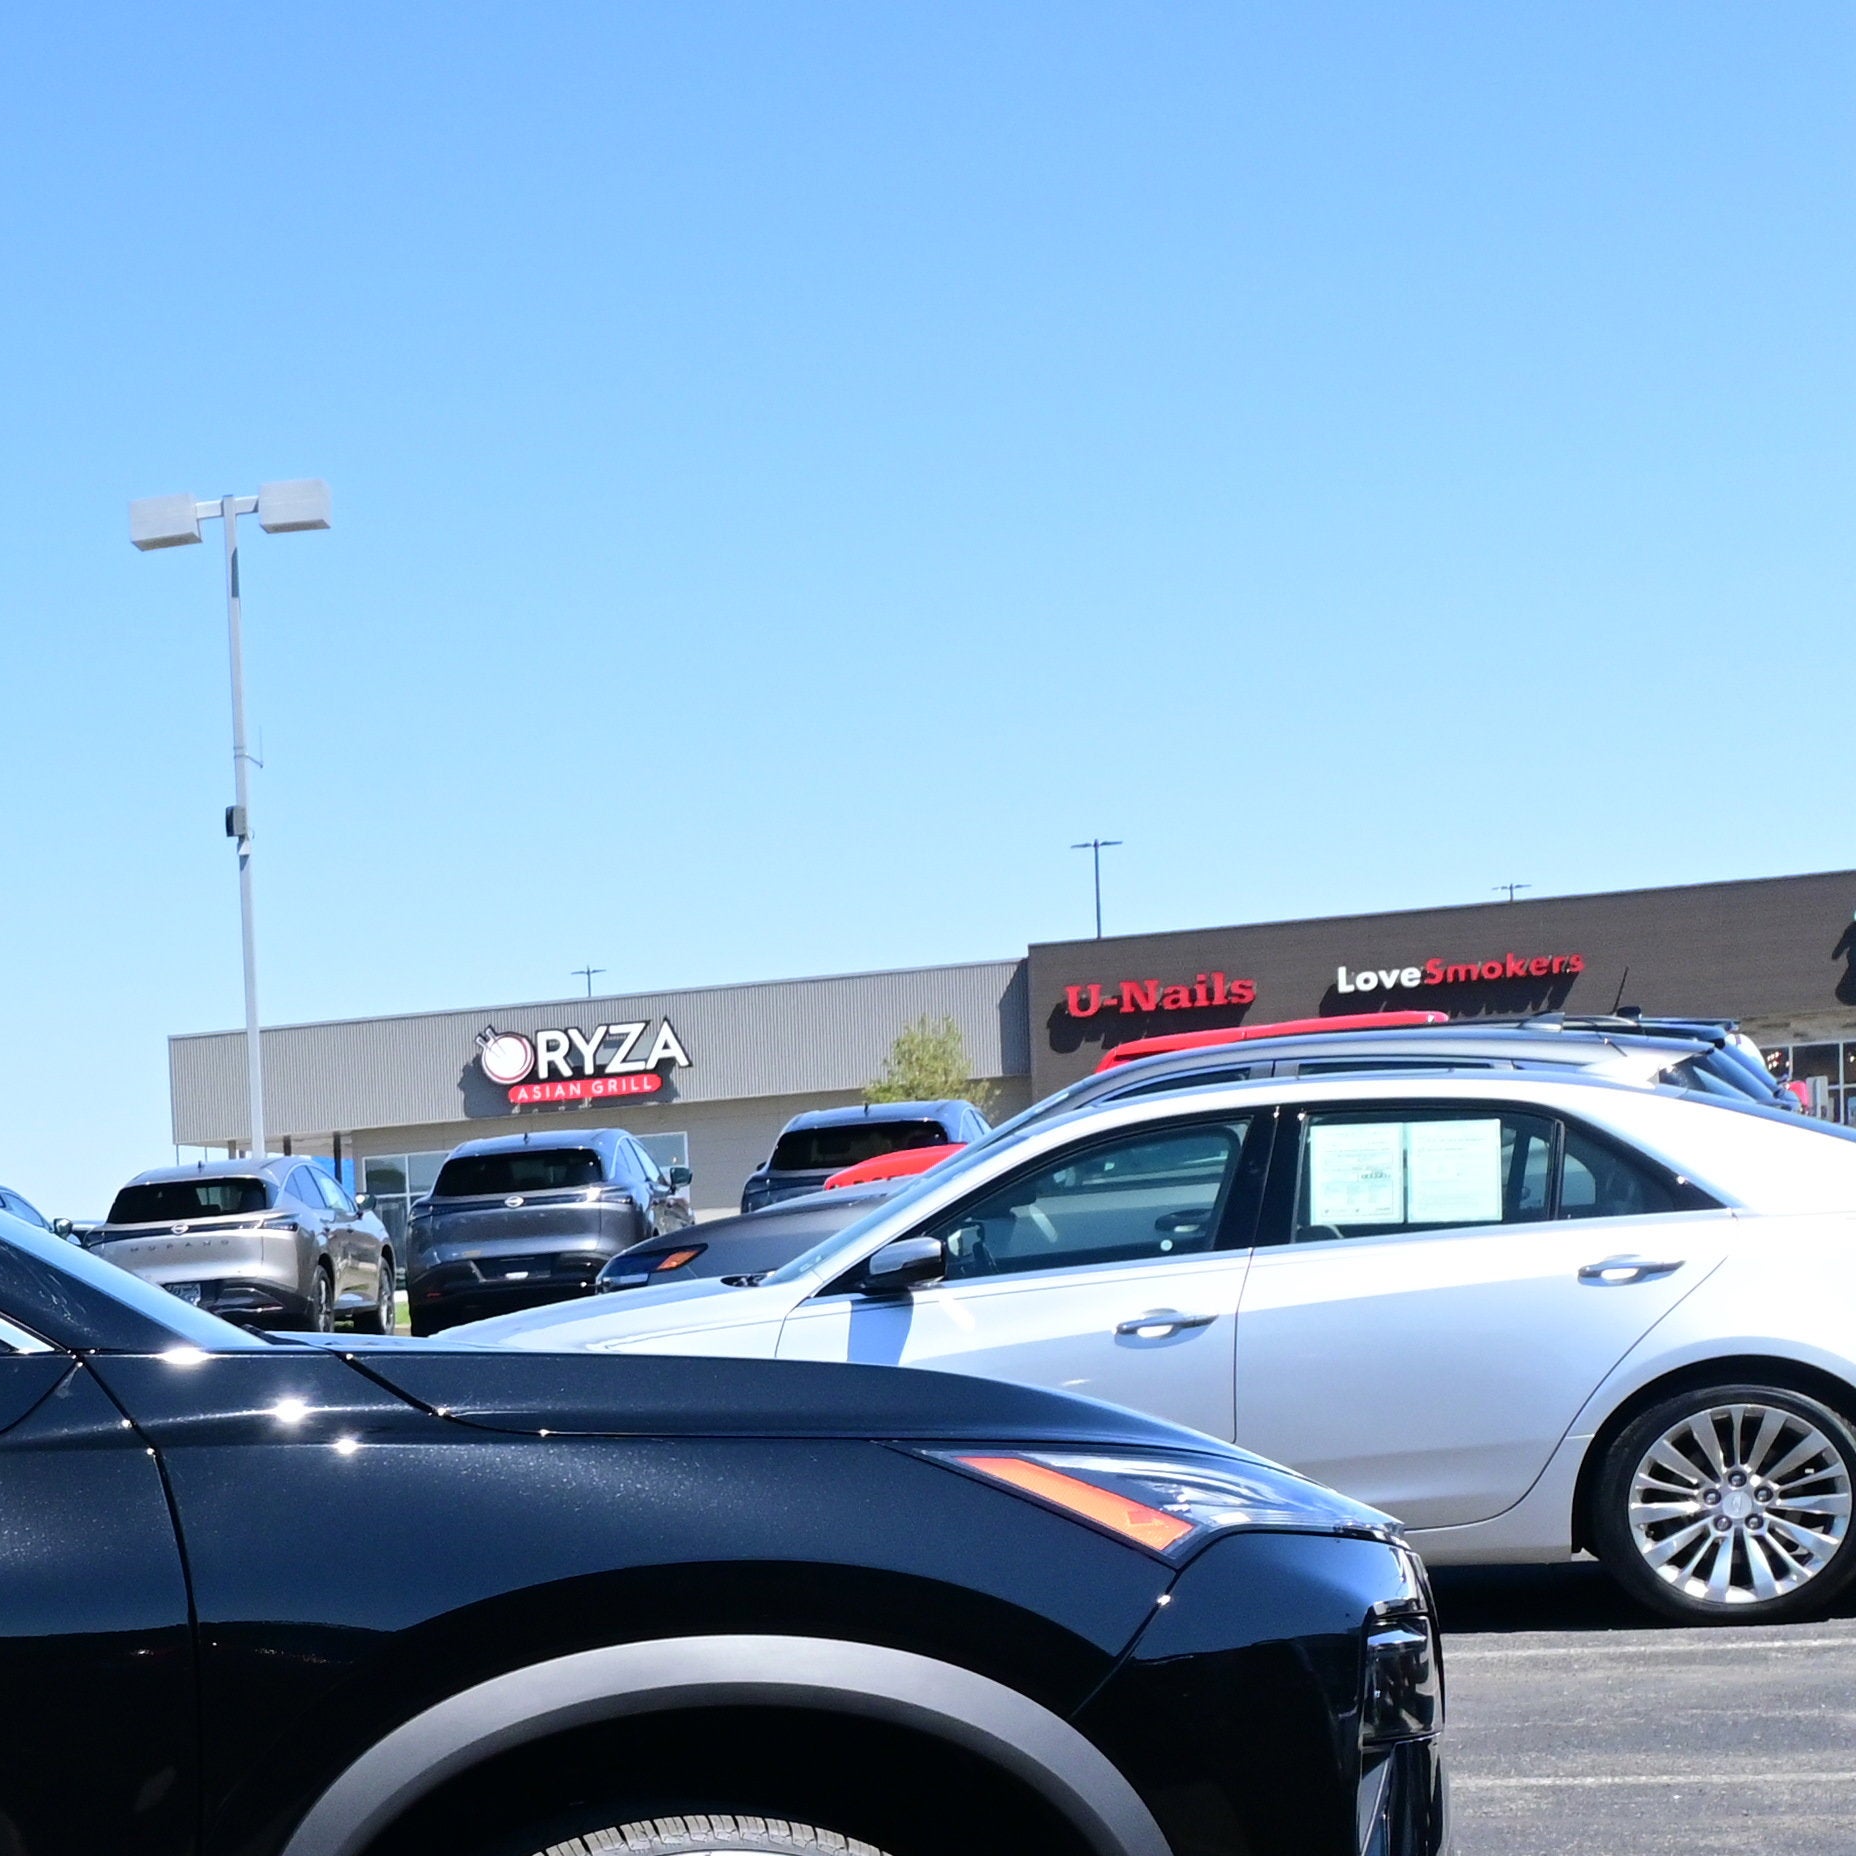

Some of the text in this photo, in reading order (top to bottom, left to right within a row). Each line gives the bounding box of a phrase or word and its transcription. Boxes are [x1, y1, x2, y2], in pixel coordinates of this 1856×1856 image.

[1337, 952, 1584, 994] LoveSmokers
[1064, 971, 1256, 1018] U-Nails
[517, 1076, 652, 1101] ASIAN GRILL
